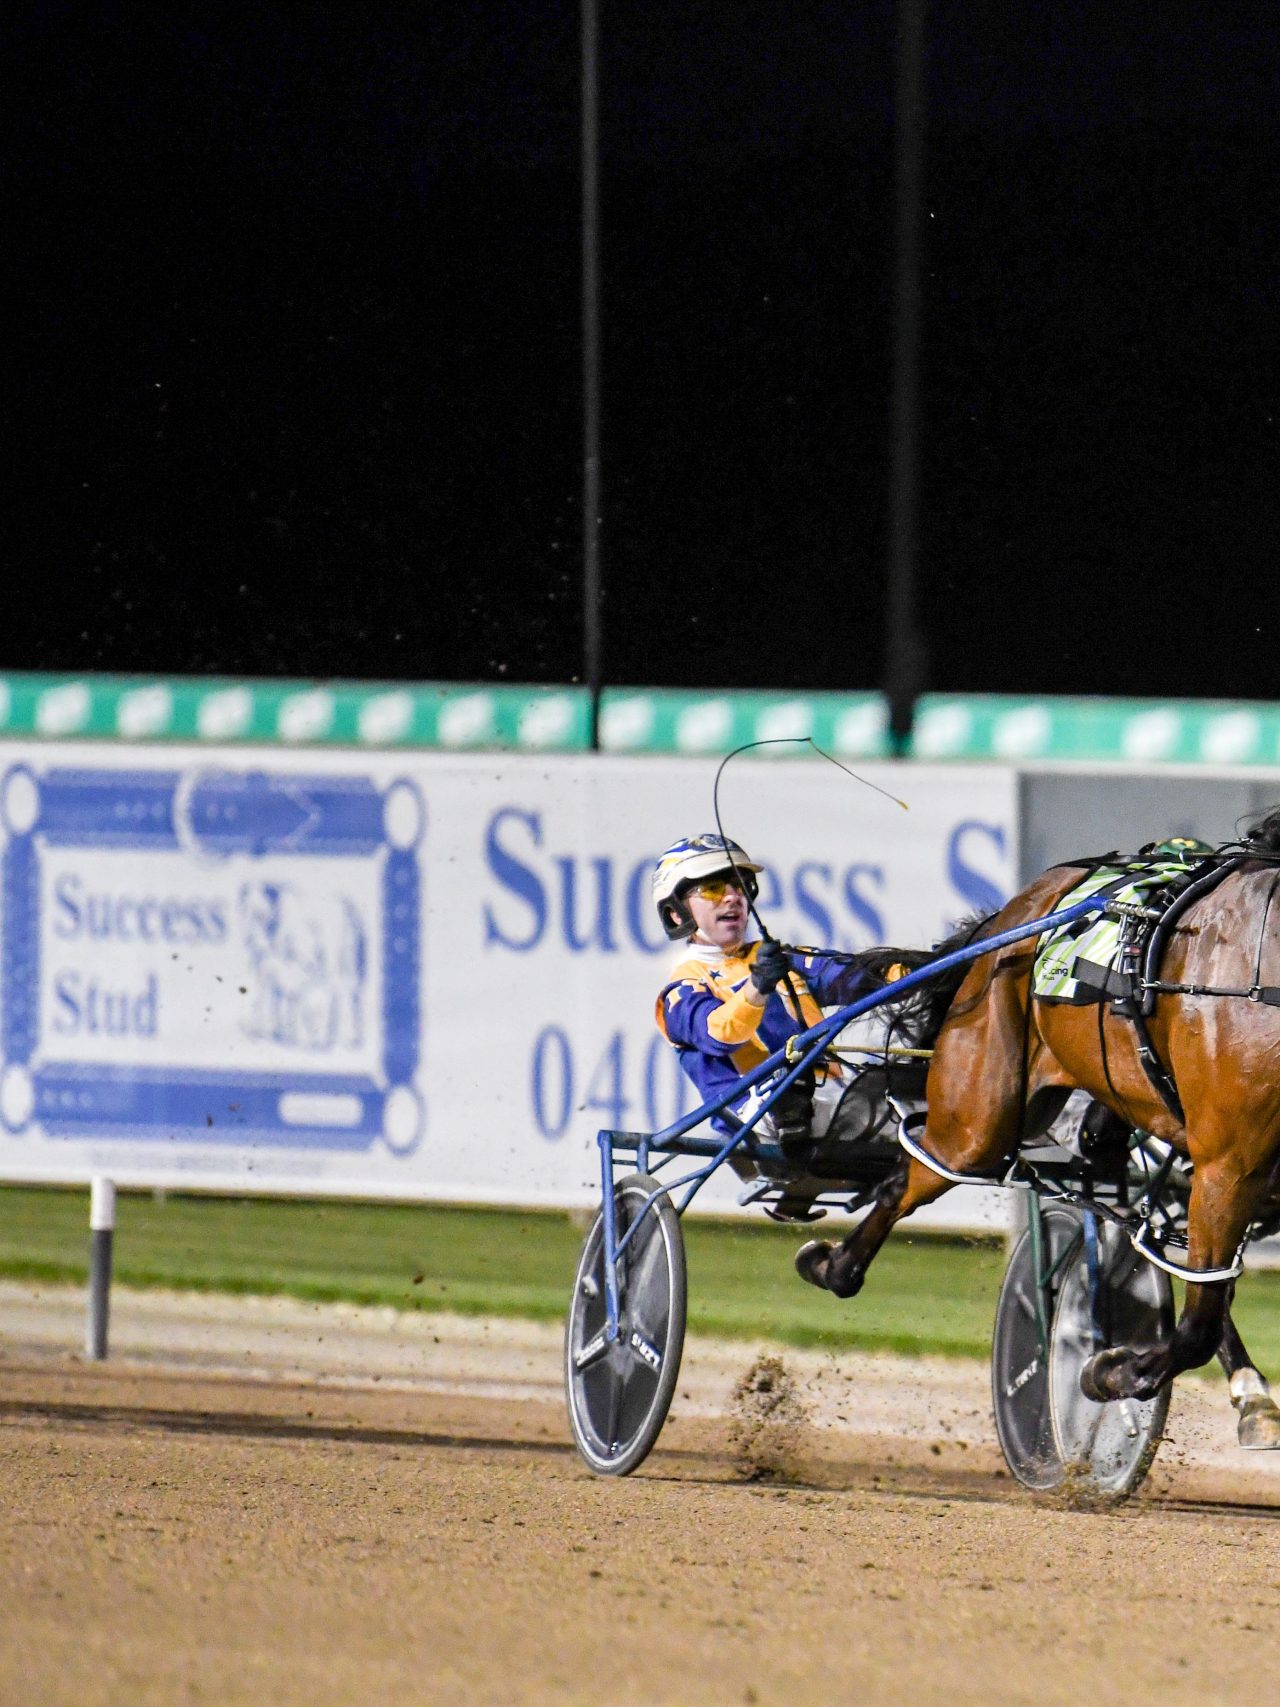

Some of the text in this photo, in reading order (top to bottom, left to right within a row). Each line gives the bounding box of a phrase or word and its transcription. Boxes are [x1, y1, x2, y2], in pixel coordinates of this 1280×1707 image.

[54, 873, 227, 943] Success
[53, 967, 158, 1036] Stud
[532, 1024, 687, 1139] 040
